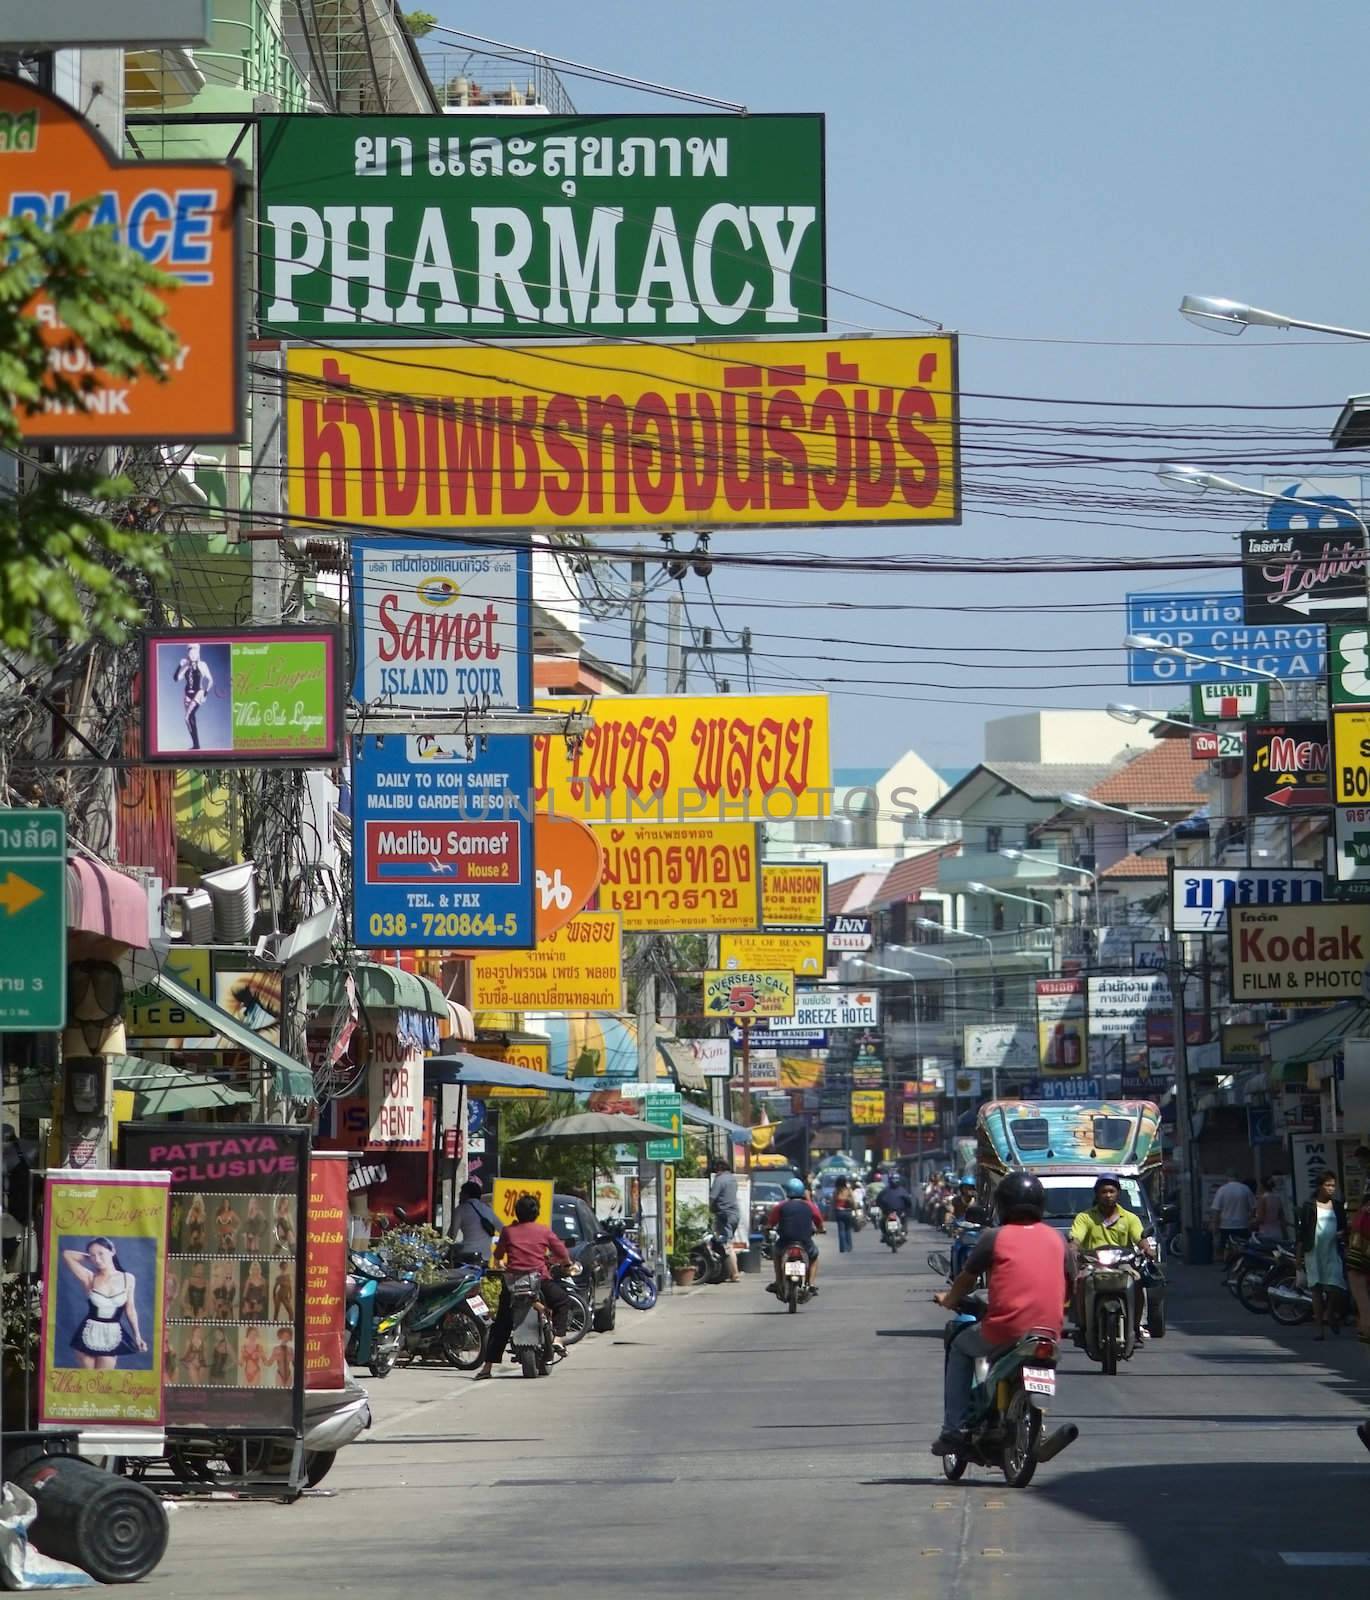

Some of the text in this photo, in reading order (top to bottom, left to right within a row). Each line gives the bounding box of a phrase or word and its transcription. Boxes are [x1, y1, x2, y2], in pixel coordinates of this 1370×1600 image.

[355, 137, 412, 176] ยา
[267, 202, 816, 325] PHARMACY
[379, 594, 500, 661] Samet
[381, 667, 503, 697] ISLAND TOUR
[1219, 737, 1242, 755] 24
[690, 717, 813, 799] พลอย
[377, 772, 509, 787] DAILY TO KOH SAMET
[367, 794, 520, 808] MALIBU GARDEN RESORT
[378, 830, 509, 855] Malibu Samet
[467, 863, 509, 877] House 2
[773, 875, 820, 893] MANSION
[407, 893, 480, 907] TEL. & FAX
[612, 888, 738, 911] เยาวราช
[765, 895, 817, 904] FOR RENT
[369, 913, 407, 936] 038
[422, 913, 517, 936] 720864-5
[734, 938, 811, 947] FULL OF BEANS
[1240, 926, 1364, 963] Kodak
[707, 973, 790, 996] OVERSEAS CALL
[1242, 972, 1281, 989] FILM
[1287, 973, 1298, 988] &
[728, 986, 756, 1013] 5
[798, 1008, 837, 1025] BREEZE
[842, 1007, 875, 1024] HOTEL
[383, 1068, 409, 1098] FOR
[380, 1106, 414, 1137] RENT
[149, 1136, 279, 1162] PATTAYA
[171, 1155, 297, 1182] CLUSIVE
